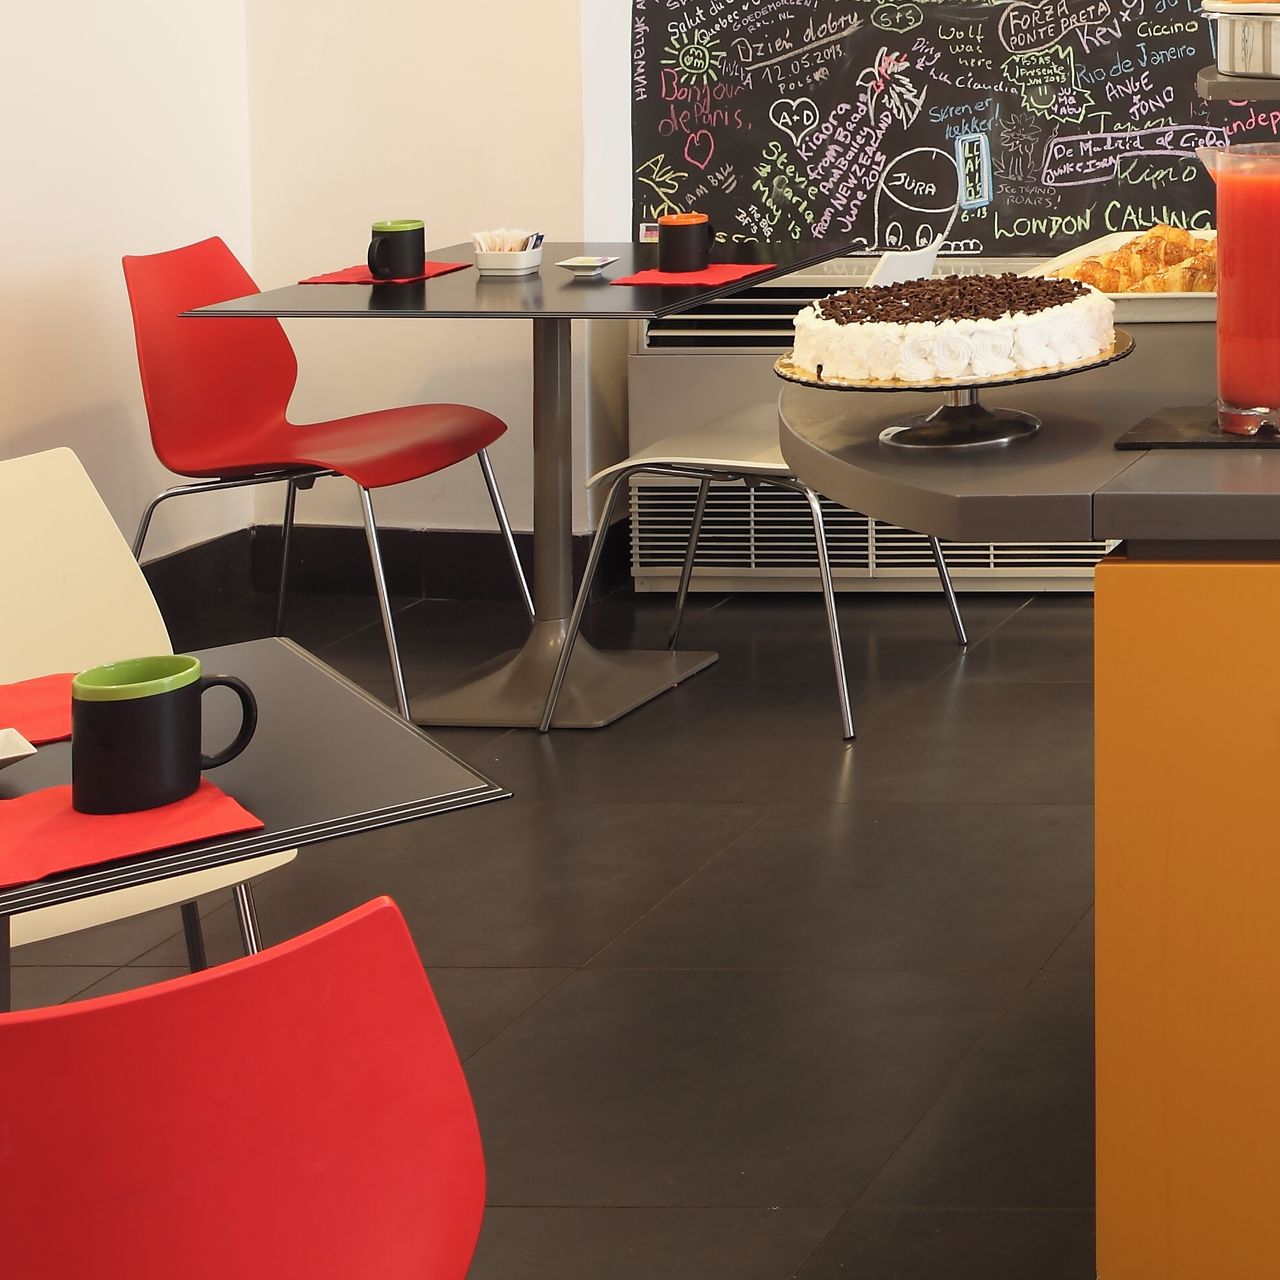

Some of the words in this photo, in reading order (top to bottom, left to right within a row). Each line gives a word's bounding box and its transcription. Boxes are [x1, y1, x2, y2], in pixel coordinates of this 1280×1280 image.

[668, 11, 706, 40] Salut
[1010, 0, 1070, 34] FORZA
[1010, 26, 1054, 49] PONTE
[1110, 57, 1134, 76] de
[1137, 43, 1196, 66] Janeiro
[890, 174, 936, 195] JURA
[995, 202, 1096, 239] LONDON
[1104, 201, 1211, 230] CALLING
